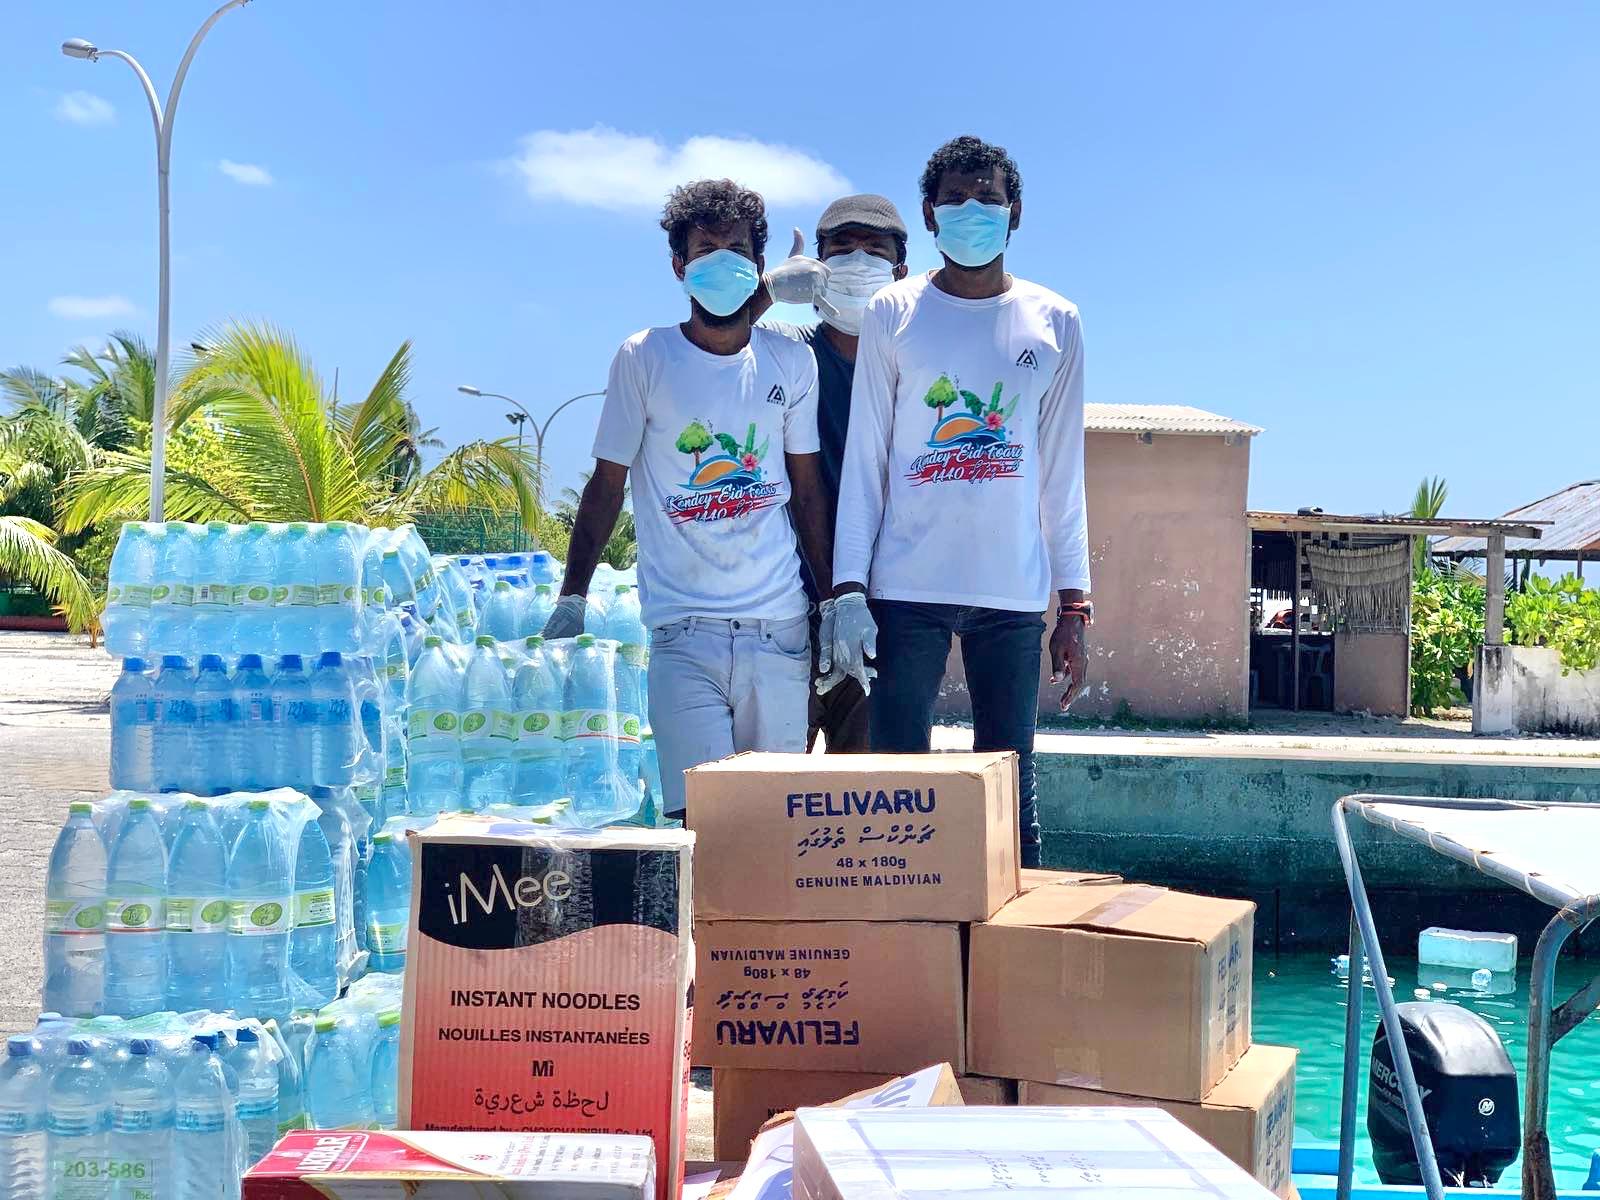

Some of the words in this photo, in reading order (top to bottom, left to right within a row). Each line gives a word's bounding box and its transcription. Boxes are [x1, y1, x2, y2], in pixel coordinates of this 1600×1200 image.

[786, 788, 936, 818] FELIVARU
[836, 857, 853, 868] 48
[858, 858, 867, 868] x
[871, 856, 906, 869] 180g
[795, 876, 858, 888] GENUINE
[863, 873, 941, 886] MALDIVIAN
[444, 863, 571, 925] iMee
[710, 950, 785, 961] MALDIVIAN
[790, 949, 850, 960] GENUINE
[744, 966, 777, 979] 180g
[781, 968, 790, 976] x
[794, 967, 811, 979] 48
[450, 990, 537, 1009] INSTANT
[542, 992, 641, 1011] NOODLES
[438, 1028, 521, 1042] NOUILLES
[525, 1026, 650, 1045] INSTANTANÉES
[716, 1020, 860, 1046] FELIVARU
[1371, 1056, 1433, 1103] MERCY
[295, 1136, 352, 1171] AKBAR
[63, 1160, 145, 1179] 203-586
